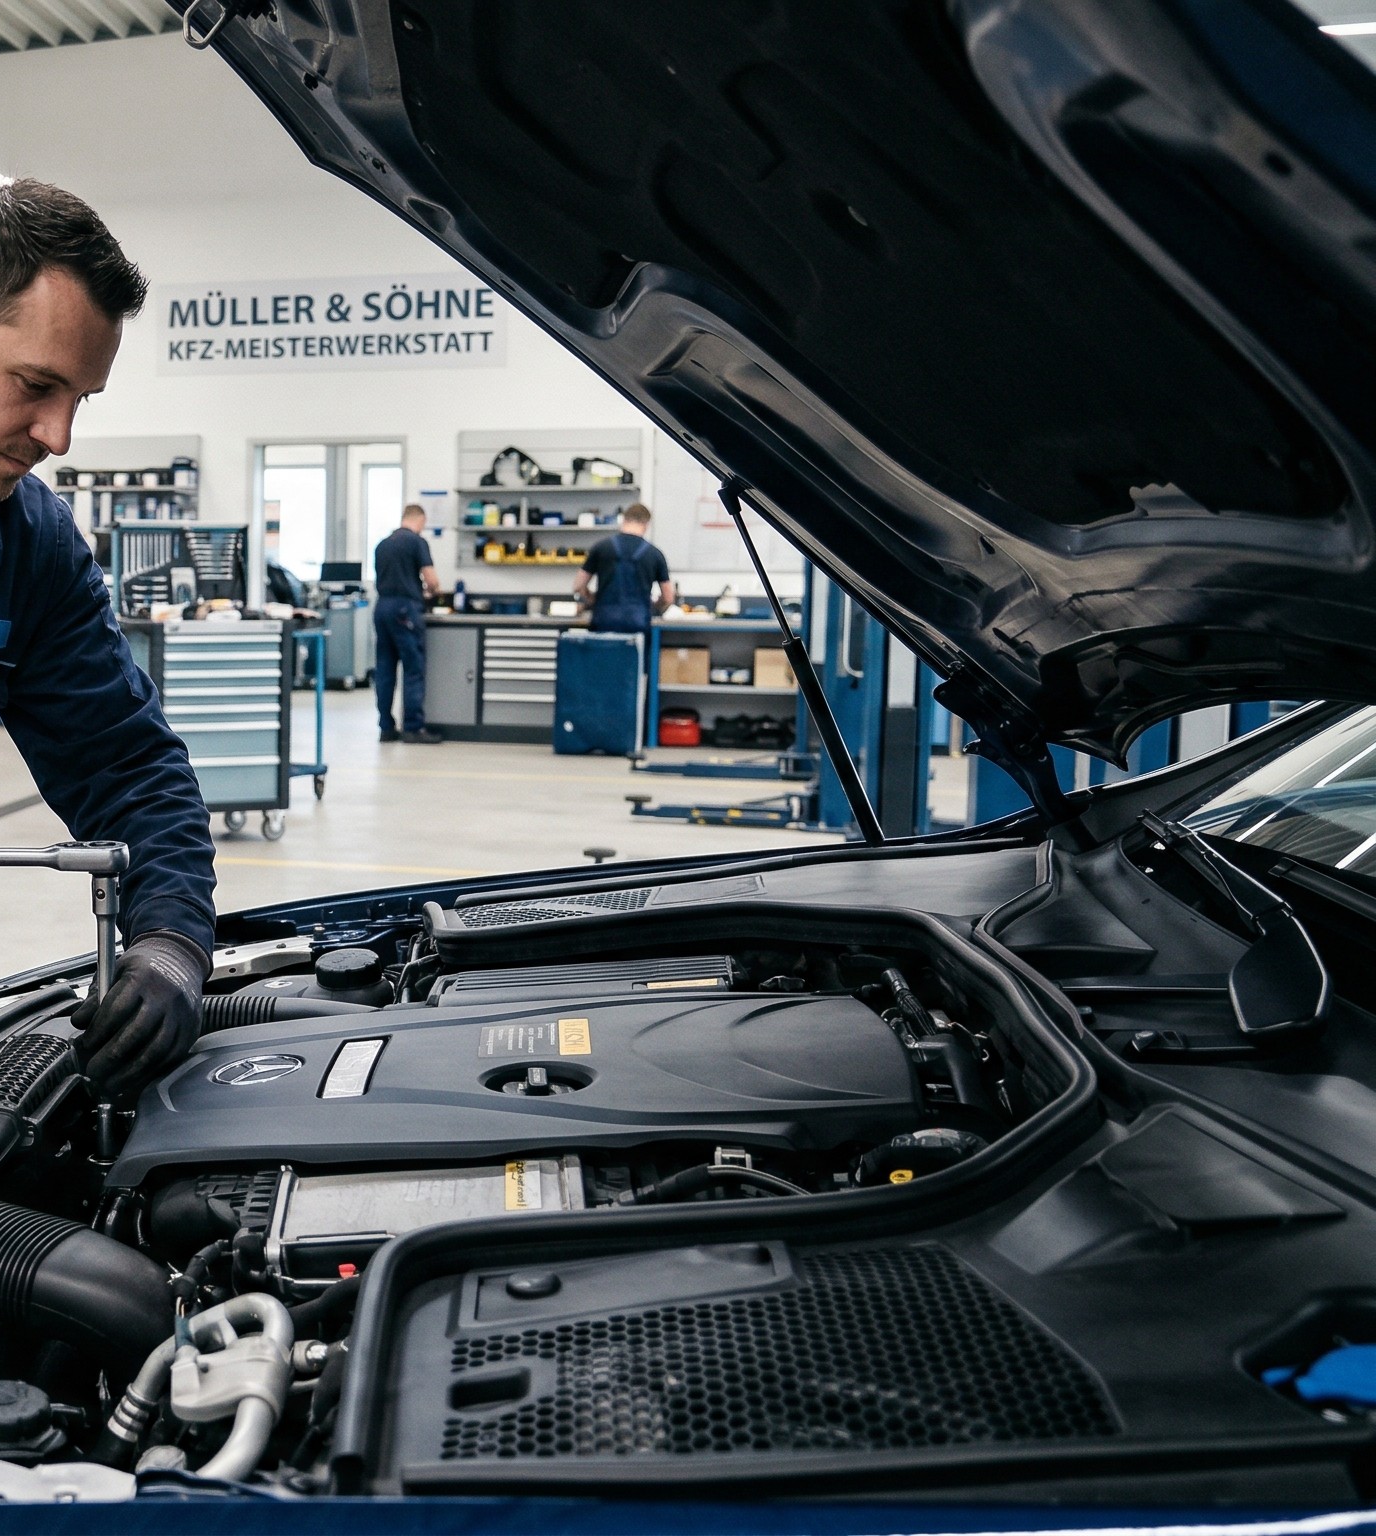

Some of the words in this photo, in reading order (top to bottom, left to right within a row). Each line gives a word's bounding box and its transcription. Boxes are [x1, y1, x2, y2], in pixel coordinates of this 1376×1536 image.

[169, 290, 315, 328] MÜLLER
[326, 293, 351, 322] &
[362, 284, 494, 321] SÖHNE
[169, 331, 494, 361] KFZ-MEISTERWERKSTATT
